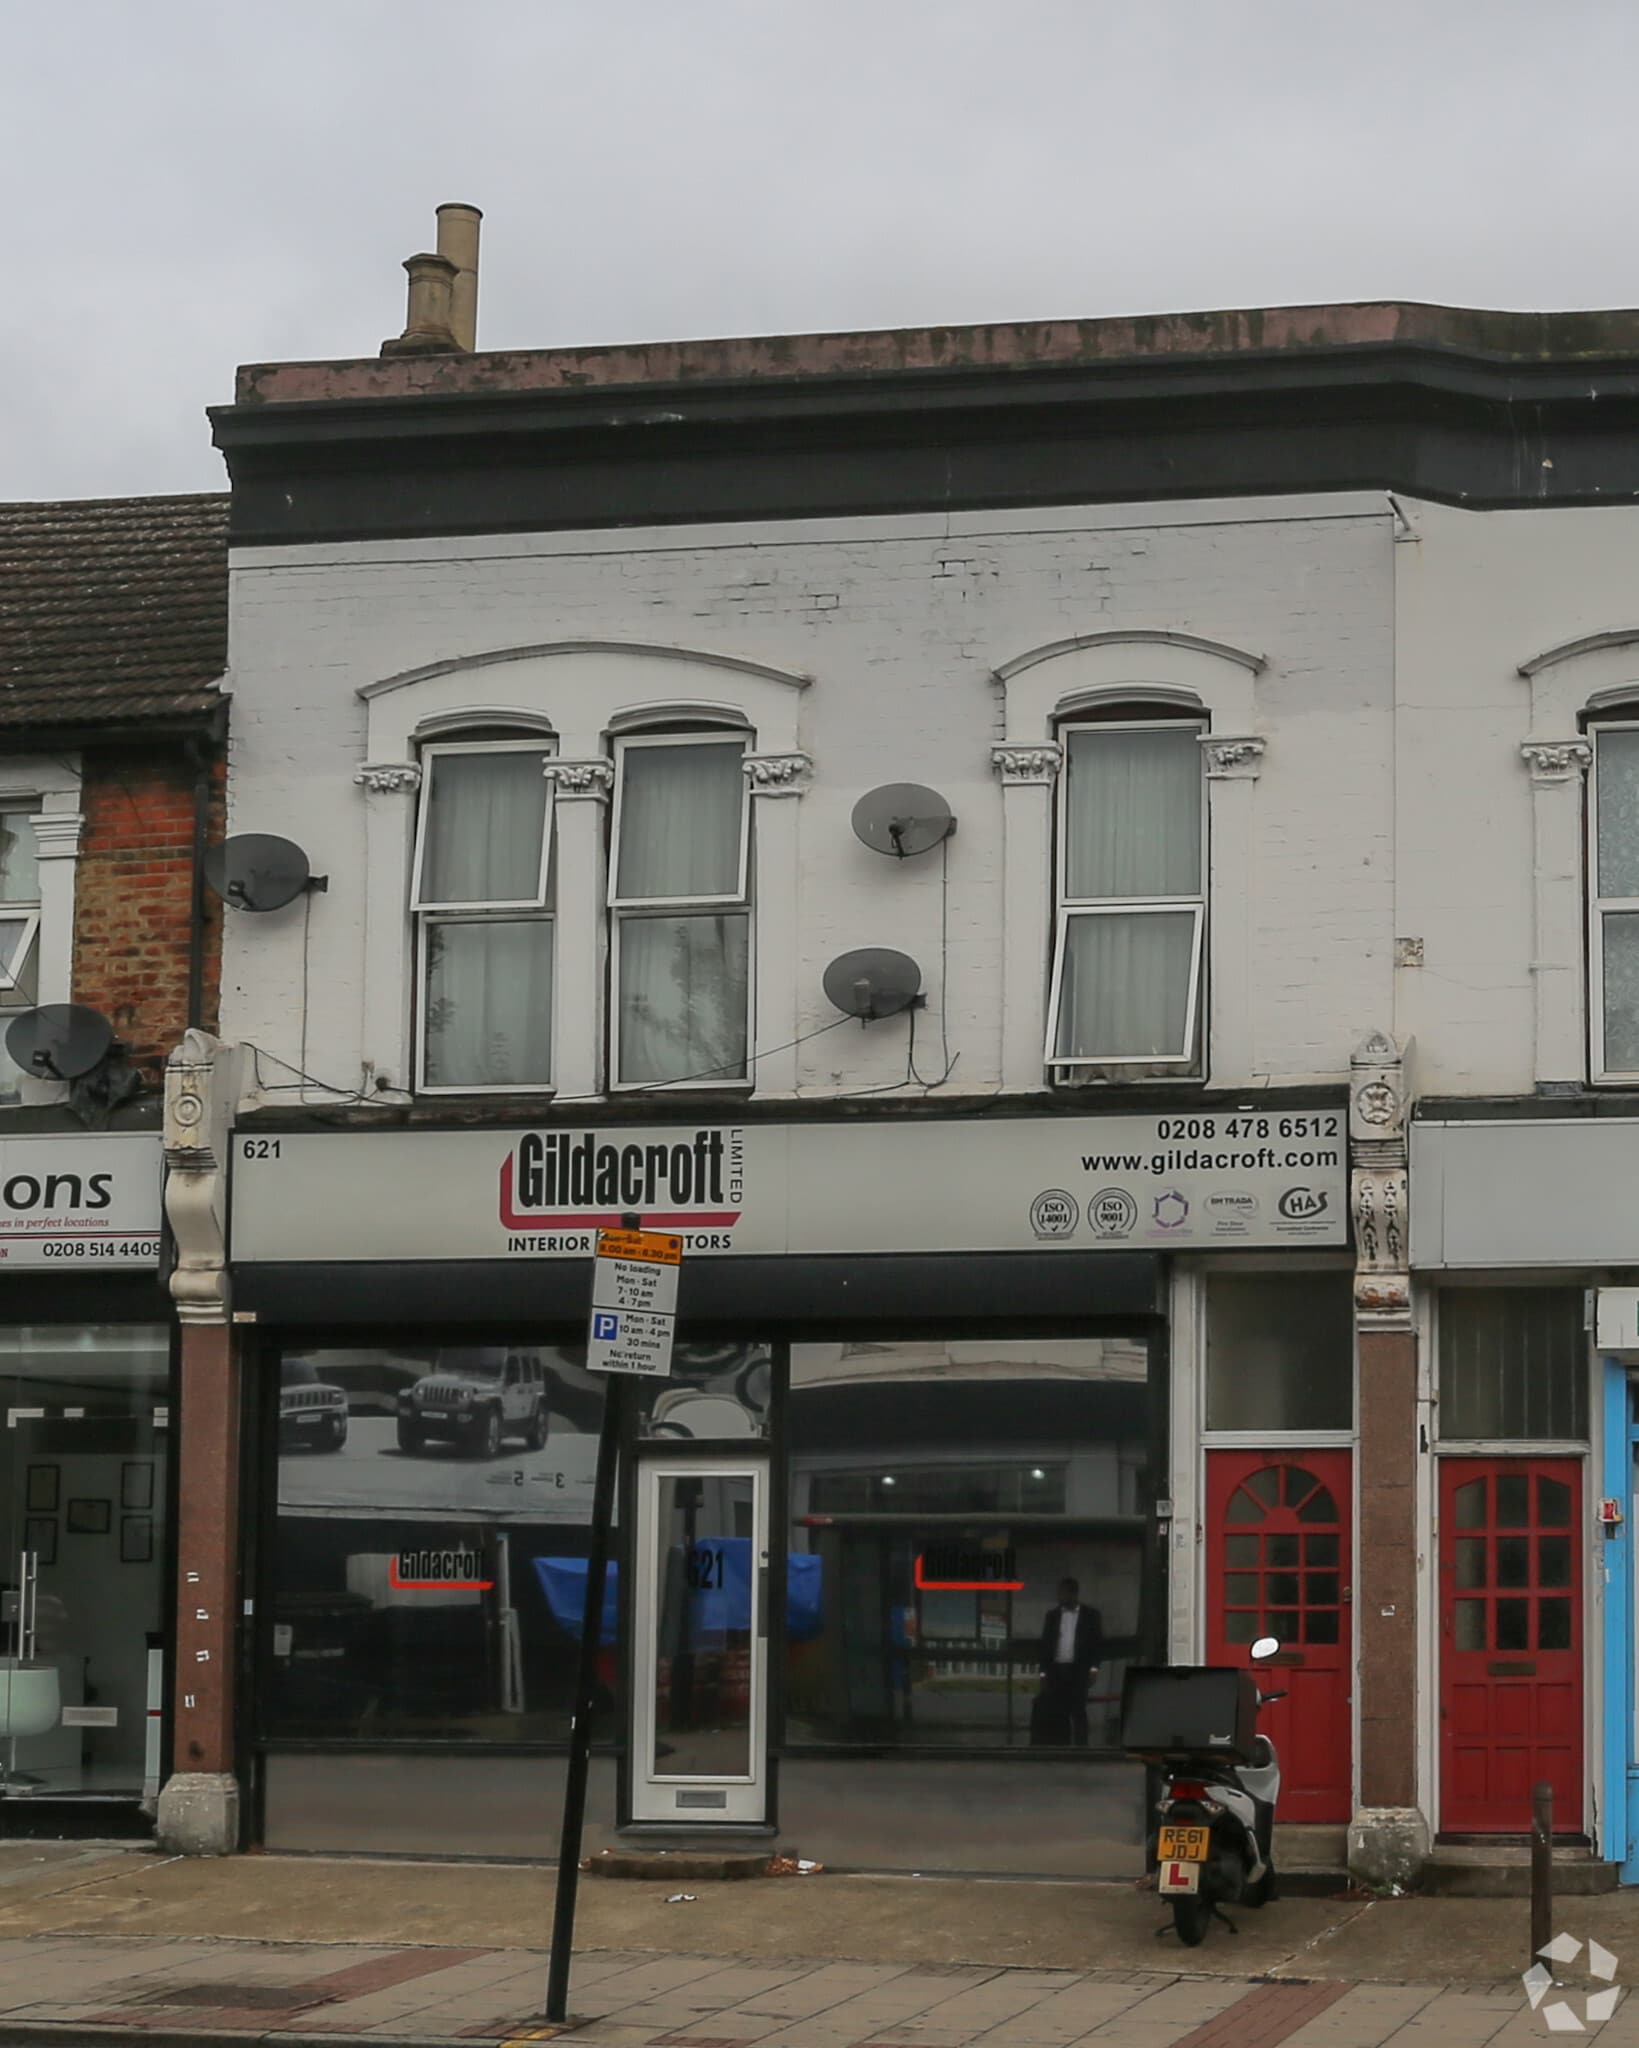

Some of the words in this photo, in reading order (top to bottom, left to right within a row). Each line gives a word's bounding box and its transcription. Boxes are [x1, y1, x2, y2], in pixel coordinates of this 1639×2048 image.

[1158, 1119, 1215, 1140] 0208
[1225, 1118, 1269, 1139] 478
[1278, 1117, 1338, 1138] 6512
[243, 1140, 281, 1159] 621
[730, 1128, 743, 1203] LIMITED
[1081, 1147, 1338, 1175] www.gildacroft.com
[519, 1130, 723, 1208] Gildacroft
[1045, 1203, 1064, 1213] ISO
[1102, 1202, 1122, 1211] ISO
[1278, 1187, 1328, 1219] CHAS
[14, 1218, 24, 1228] in
[25, 1217, 62, 1230] perfect
[64, 1216, 110, 1228] locations
[1041, 1214, 1067, 1223] 14001
[1100, 1213, 1122, 1222] 9001
[43, 1242, 85, 1257] 0208
[89, 1242, 115, 1257] 514
[119, 1242, 161, 1256] 4409
[508, 1236, 590, 1251] INTERIOR
[685, 1234, 731, 1250] TORS
[615, 1262, 627, 1271] No
[630, 1264, 661, 1276] loading
[616, 1275, 635, 1284] Mon
[641, 1278, 657, 1287] Sat
[629, 1288, 639, 1296] 10
[599, 1317, 614, 1337] P
[626, 1314, 644, 1323] Mon
[650, 1317, 666, 1326] Sat
[620, 1325, 629, 1333] 10
[657, 1330, 670, 1338] pm
[641, 1341, 660, 1349] mins
[624, 1352, 651, 1360] return
[602, 1360, 629, 1369] within
[637, 1362, 656, 1371] hour
[1163, 1828, 1203, 1843] RE61
[1165, 1844, 1200, 1859] JDJ
[1168, 1863, 1189, 1886] L
